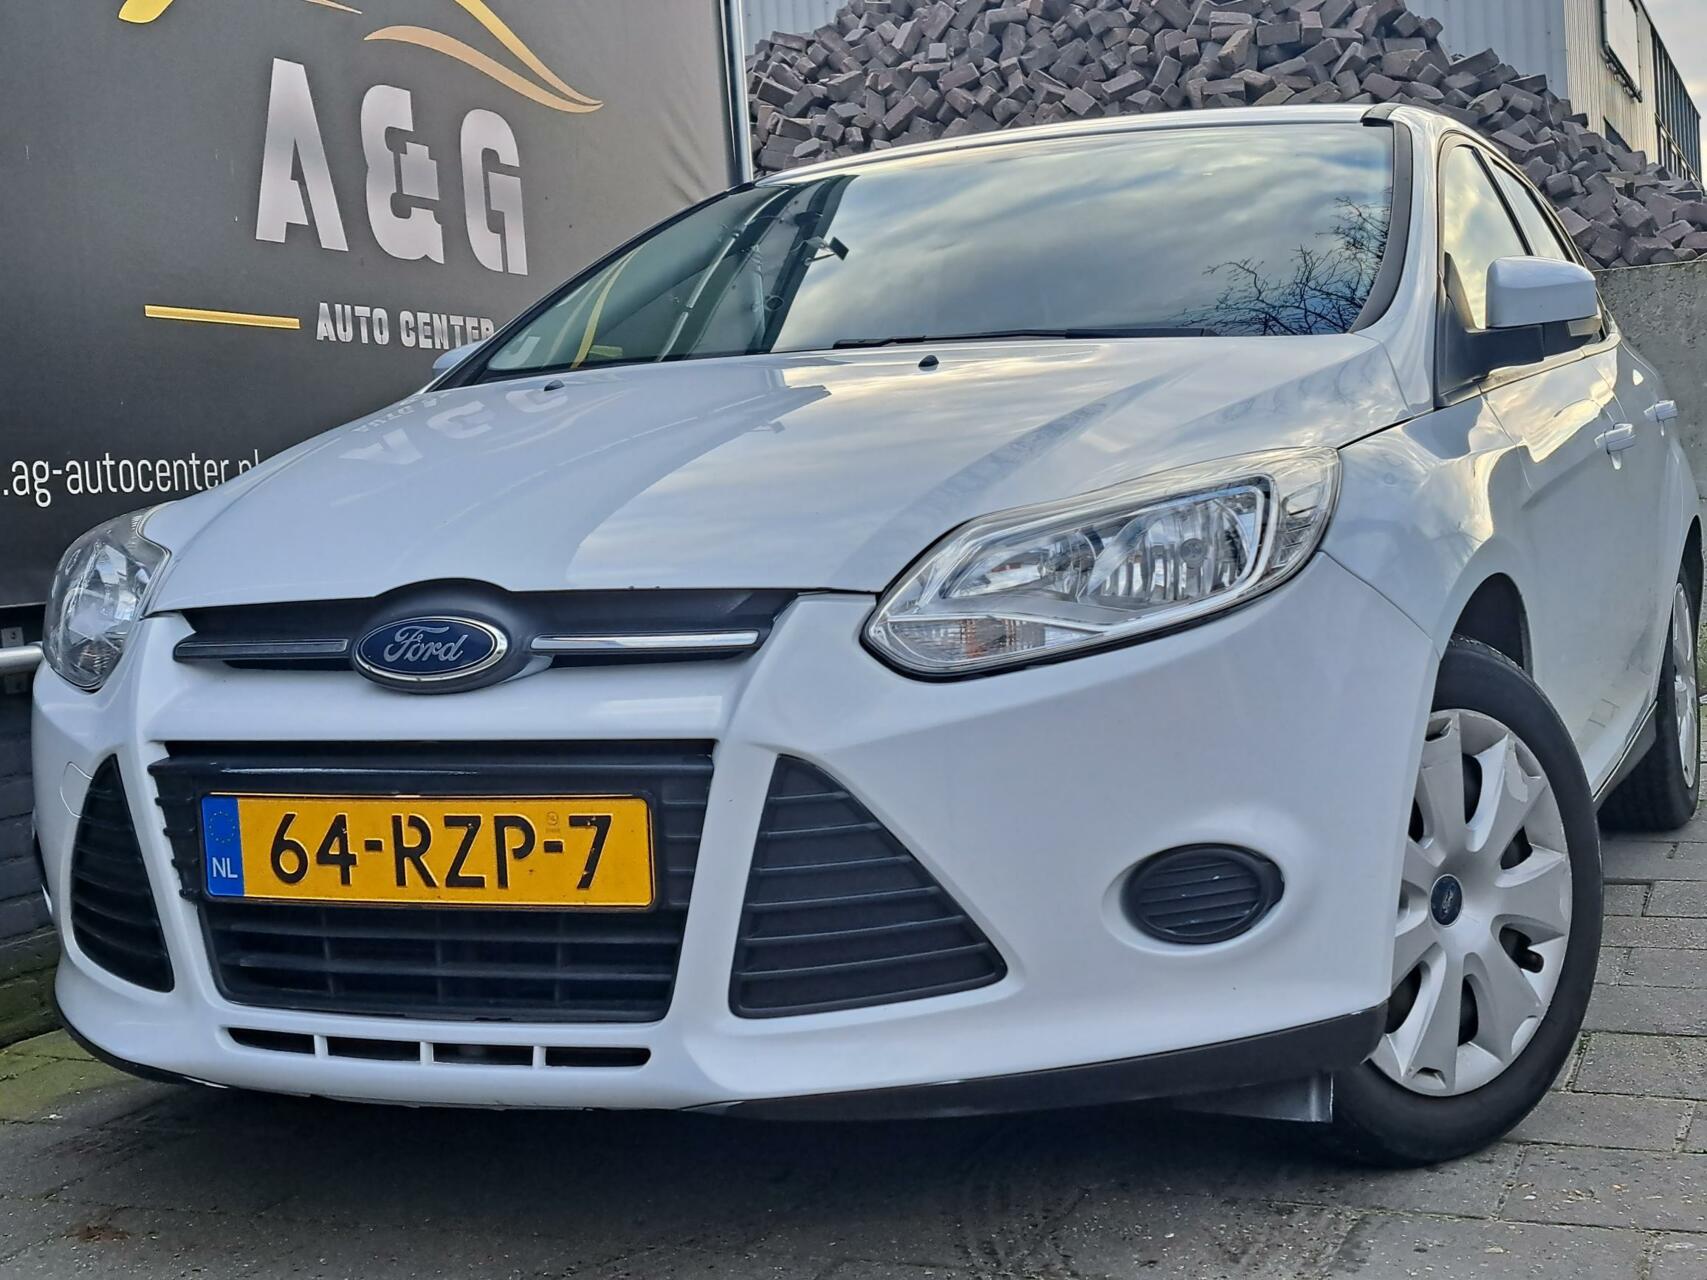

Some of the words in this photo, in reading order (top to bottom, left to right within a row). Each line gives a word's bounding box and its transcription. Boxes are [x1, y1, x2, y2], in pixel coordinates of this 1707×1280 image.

[256, 58, 528, 276] A&G
[316, 302, 390, 345] AUTO
[2, 448, 259, 508] .ag-autocentern
[383, 625, 468, 663] Ford
[211, 857, 238, 879] NL
[269, 811, 613, 891] 64-RZP-7
